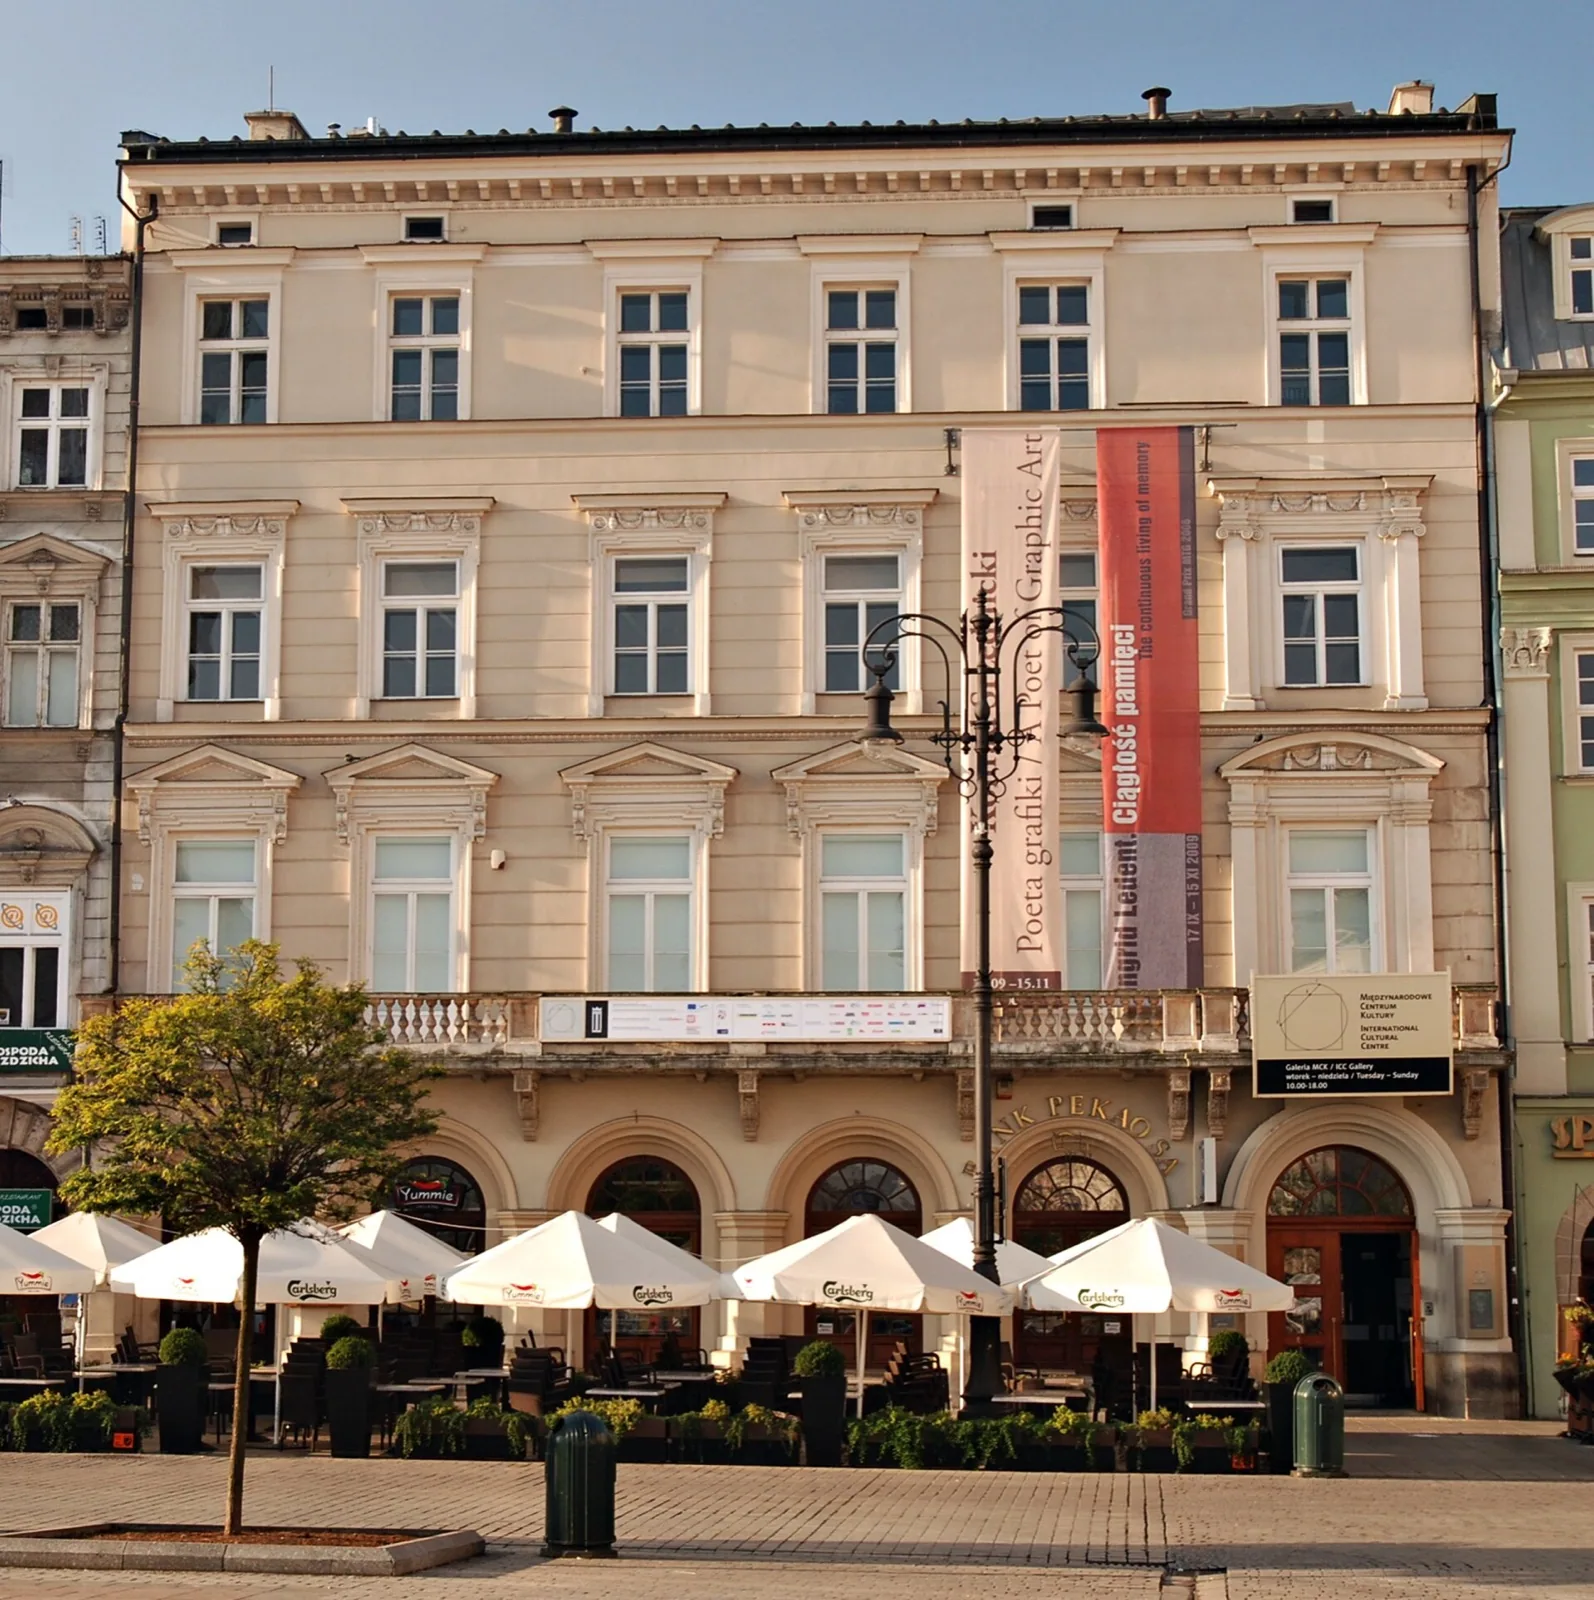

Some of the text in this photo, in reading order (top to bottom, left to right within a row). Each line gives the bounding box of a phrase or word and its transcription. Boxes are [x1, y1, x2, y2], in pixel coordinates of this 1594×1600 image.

[1015, 433, 1043, 480] Art
[1014, 488, 1051, 603] Graphic
[1135, 441, 1153, 661] The continuous living of memory
[1182, 567, 1192, 587] Prix
[1182, 588, 1193, 617] Grand
[1013, 608, 1042, 640] of
[1015, 649, 1042, 711] Poet
[1110, 624, 1140, 825] Ciągłość pamięci
[1013, 775, 1052, 866] grafiki
[1186, 834, 1199, 864] 2009
[1186, 868, 1199, 880] XI
[1186, 883, 1199, 898] 15
[1015, 876, 1043, 954] Poeta
[1186, 912, 1199, 925] IX
[1186, 932, 1200, 943] 17
[1114, 926, 1141, 987] ngrid
[1360, 1002, 1397, 1010] CENTRUM
[1360, 1024, 1419, 1032] INTERNATIONAL
[1360, 1033, 1399, 1041] CULTURAL
[1361, 1042, 1390, 1050] CENTRE
[0, 1056, 59, 1066] ZDZICHA
[1285, 1063, 1310, 1071] Galeria
[1349, 1063, 1374, 1072] Gallery
[1285, 1082, 1328, 1090] 10.00-18.00
[1318, 1072, 1349, 1080] niedziela
[1356, 1072, 1385, 1081] Tuesday
[1392, 1071, 1419, 1080] Sunday
[1047, 1094, 1151, 1138] PEKAO
[400, 1187, 454, 1201] Yummie
[0, 1205, 31, 1214] ODA
[0, 1215, 41, 1224] ZICHA
[287, 1280, 337, 1300] Carlsberg
[506, 1290, 541, 1300] Yummie
[633, 1285, 673, 1305] Carlsberg
[823, 1281, 873, 1302] Carlsberg
[1078, 1289, 1124, 1309] Carlsberg
